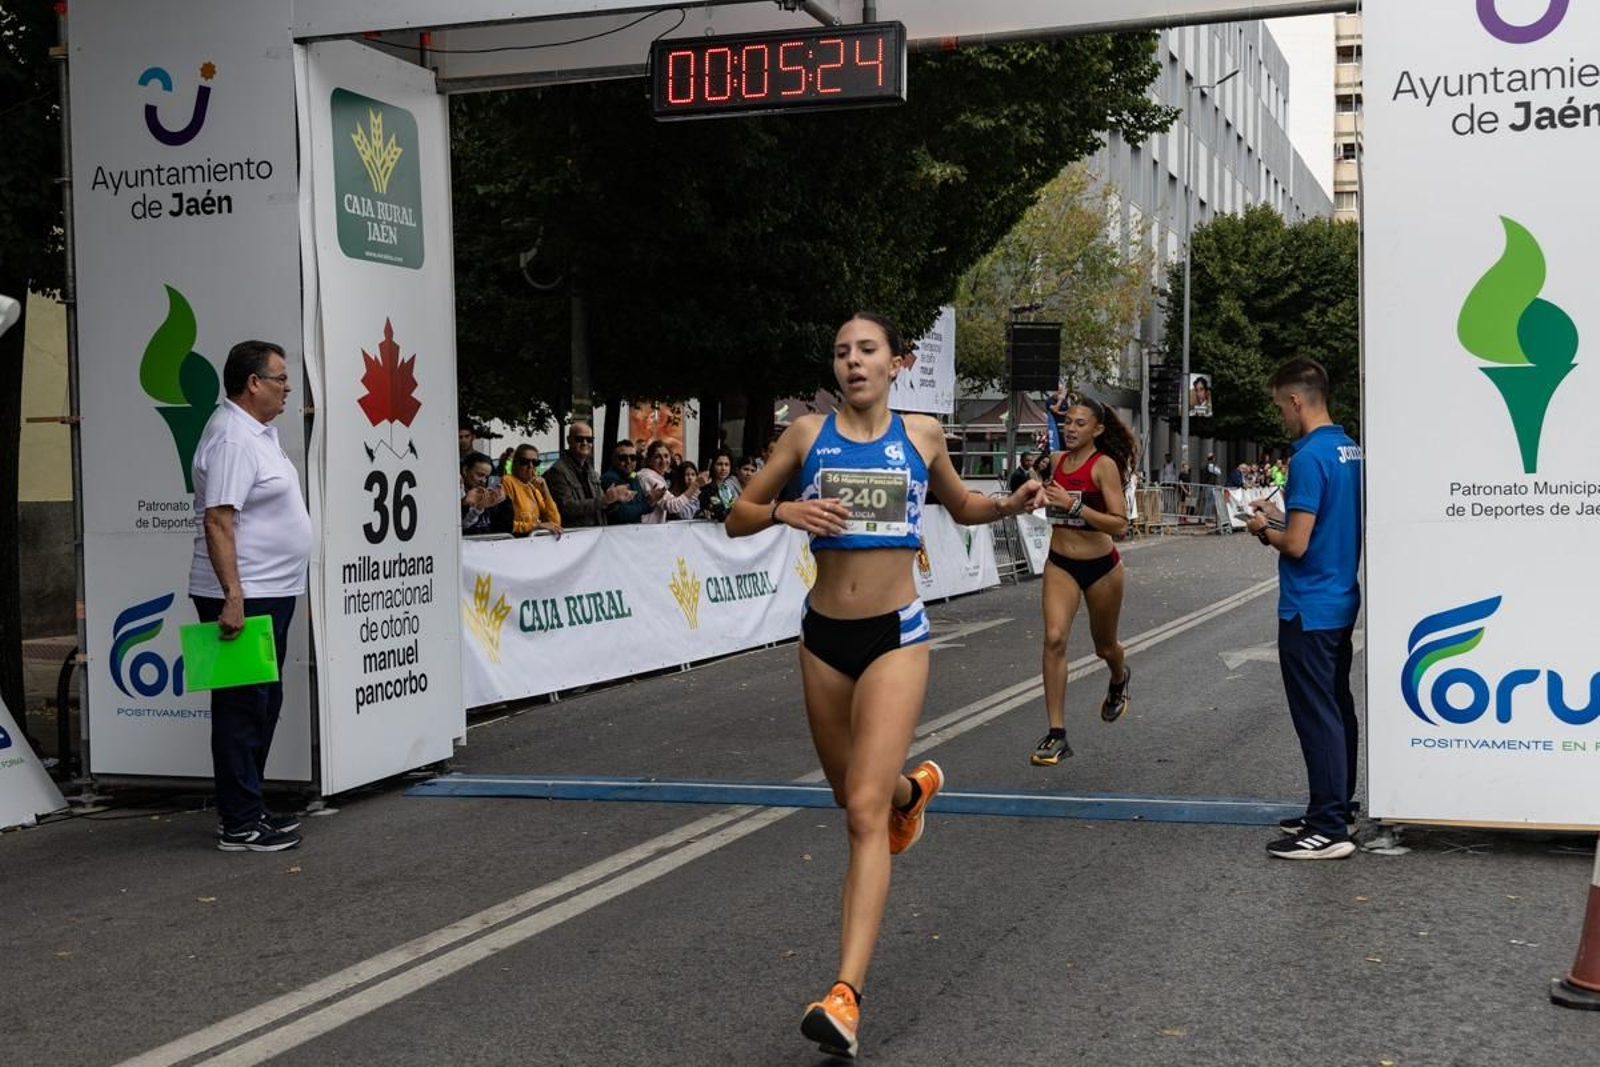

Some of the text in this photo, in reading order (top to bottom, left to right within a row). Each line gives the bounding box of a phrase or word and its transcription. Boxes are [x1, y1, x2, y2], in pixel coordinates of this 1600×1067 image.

[669, 37, 883, 104] 00:05:24
[1392, 58, 1600, 107] Ayuntamie
[1452, 103, 1499, 135] de
[92, 157, 273, 196] Ayuntamiento
[131, 189, 233, 220] de Jaén
[344, 193, 417, 227] CAJA RURAL
[826, 473, 839, 483] 36
[1450, 481, 1529, 496] Patronato
[138, 500, 190, 512] Patronato
[362, 469, 418, 545] 36
[838, 487, 888, 509] 240
[1445, 503, 1466, 517] de
[1471, 502, 1545, 520] Deportes
[1550, 502, 1570, 516] de
[135, 517, 150, 529] de
[342, 553, 434, 584] milla urbana
[344, 578, 433, 615] internacional
[706, 571, 778, 603] CAJA RURAL
[360, 611, 420, 643] de otoño
[519, 589, 632, 633] CAJA RURAL
[363, 639, 419, 675] manuel
[355, 670, 428, 714] pancorbo
[116, 707, 212, 719] POSITIVAMENTE
[1411, 737, 1554, 751] POSITIVAMENTE
[1562, 741, 1586, 751] EN
